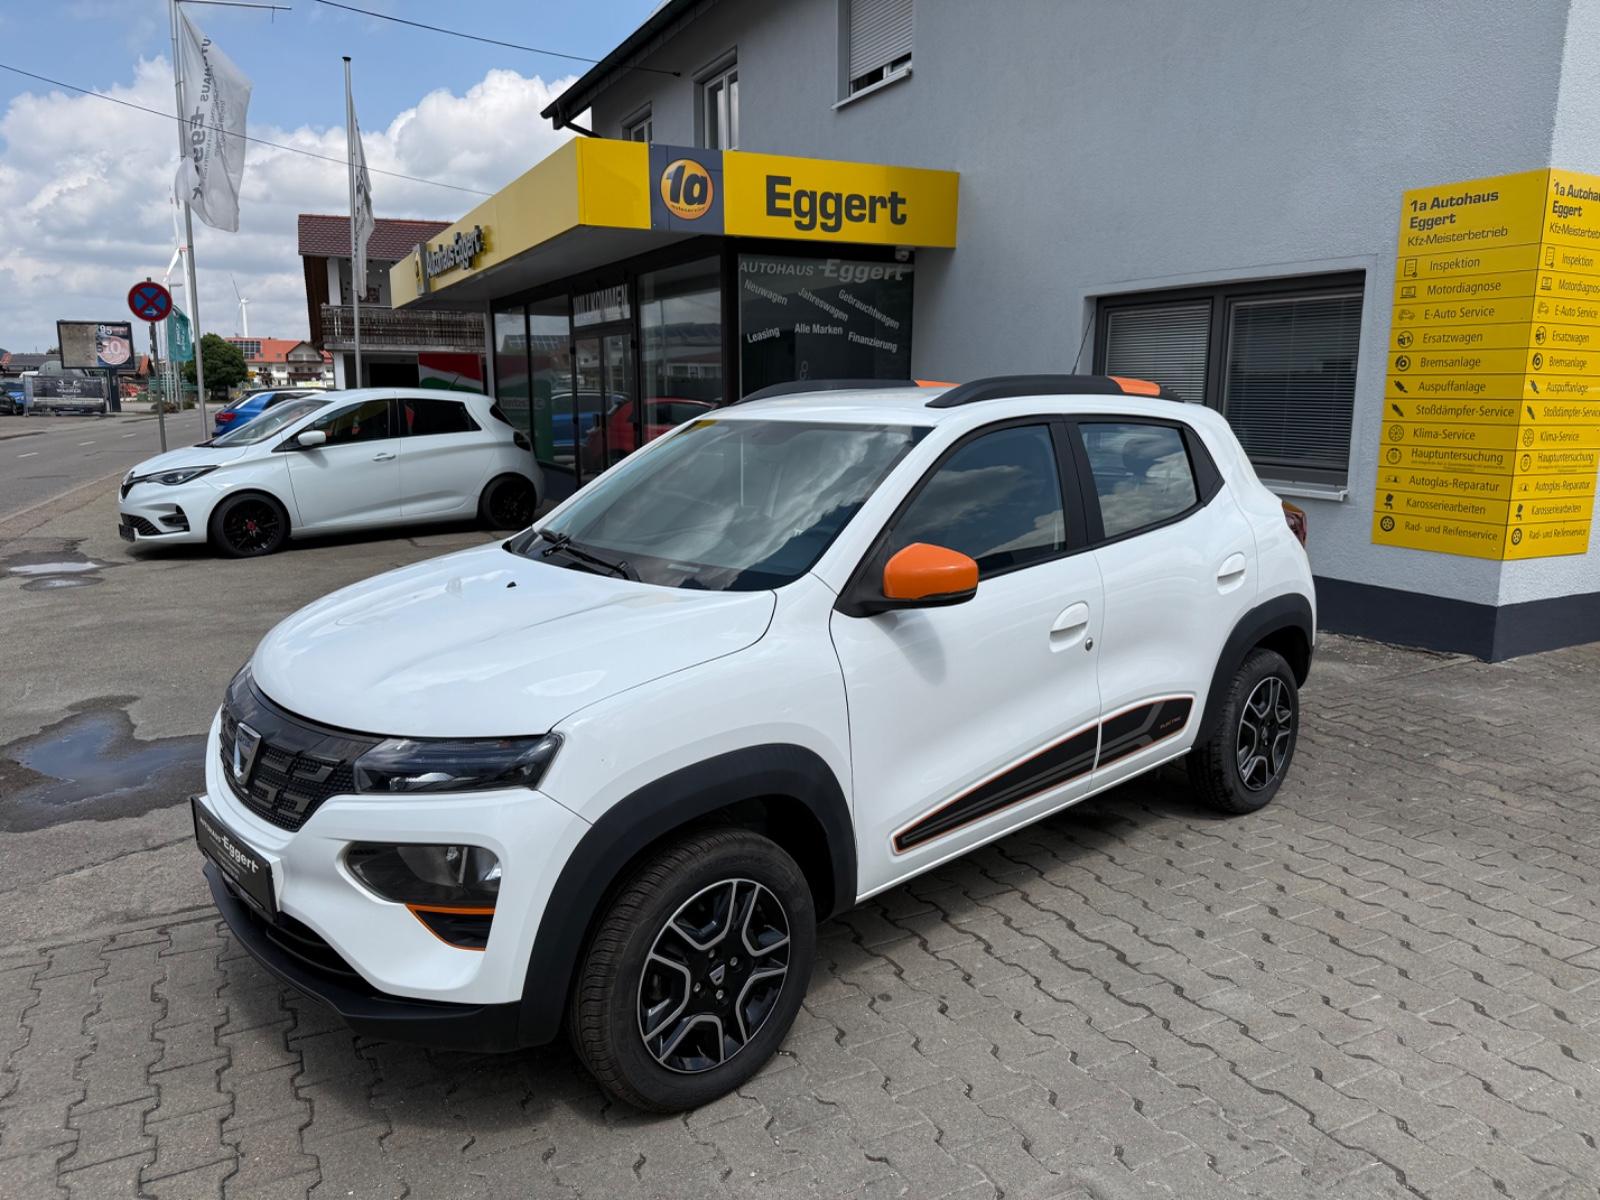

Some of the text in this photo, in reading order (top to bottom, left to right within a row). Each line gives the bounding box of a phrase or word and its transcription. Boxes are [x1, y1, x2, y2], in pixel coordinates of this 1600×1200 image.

[666, 165, 708, 205] 1a
[1554, 181, 1565, 196] 1a
[766, 174, 907, 233] Eggert
[1410, 191, 1499, 212] 1a Autohaus
[1552, 200, 1583, 218] Eggert
[1409, 212, 1456, 231] Eggert
[1407, 226, 1508, 247] Kfz-Meisterbetrieb
[427, 225, 483, 278] Autohaus Eggert
[1562, 252, 1593, 267] Inspektion
[738, 259, 905, 283] AUTOHAUS Eggert
[1430, 257, 1481, 272] Inspektion
[744, 279, 788, 305] Neuwagen
[1427, 281, 1501, 297] Motordiagnose
[798, 287, 849, 322] Jahreswagen
[838, 288, 900, 329] Gebrauchtwagen
[1554, 304, 1599, 319] E-Auto Service
[1424, 307, 1495, 319] E-Auto Service
[747, 326, 780, 343] Leasing
[794, 323, 843, 335] Alle Marken
[848, 331, 898, 353] Finanzierung
[1422, 332, 1483, 345] Ersatzwagen
[1552, 331, 1590, 345] Ersatzwagen
[1420, 357, 1481, 370] Bremsanlage
[1549, 356, 1587, 370] Bremsanlage
[1418, 381, 1486, 393] Auspuffanlage
[1546, 382, 1588, 395] Auspuffanlage
[1415, 405, 1515, 418] Stoßdämpfer-Service
[1413, 429, 1476, 441] Klima-Service
[1540, 431, 1580, 442] Klima-Service
[1411, 448, 1504, 464] Hauptuntersuchung
[1538, 451, 1594, 464] Hauptuntersuchung
[1409, 474, 1500, 491] Autoglas-Reparatur
[1535, 480, 1590, 494] Autoglas-Reparatur
[1406, 498, 1486, 515] Karosseriearbeiten
[1404, 520, 1498, 541] Rad- und Reifenservice
[222, 835, 259, 873] Eggert
